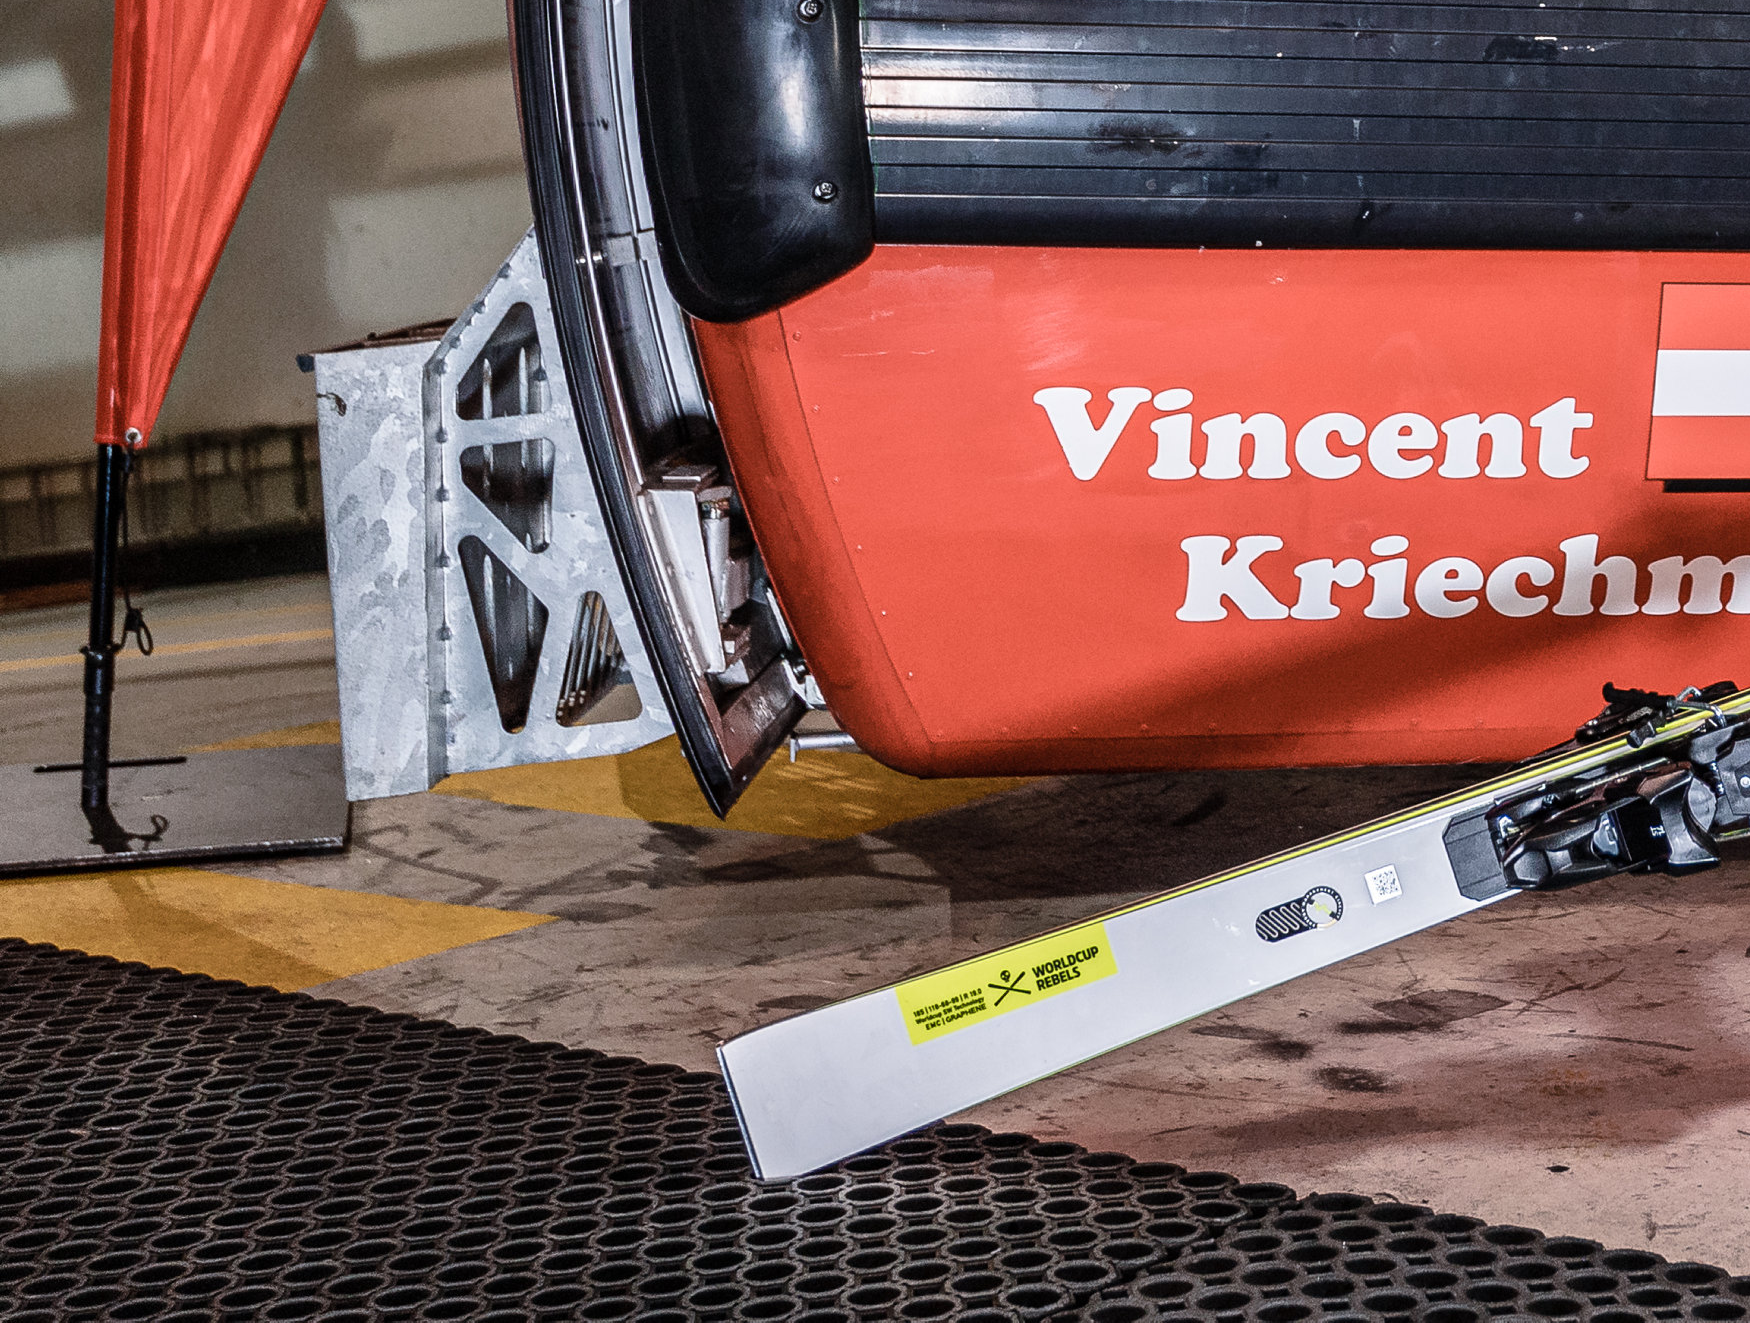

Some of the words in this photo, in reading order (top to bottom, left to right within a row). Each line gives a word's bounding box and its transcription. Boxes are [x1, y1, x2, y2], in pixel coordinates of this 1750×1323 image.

[1033, 386, 1594, 481] Vincent
[1032, 946, 1099, 978] WORLDCUP
[1036, 966, 1081, 991] REBELS
[945, 1003, 987, 1023] GRAPHENE
